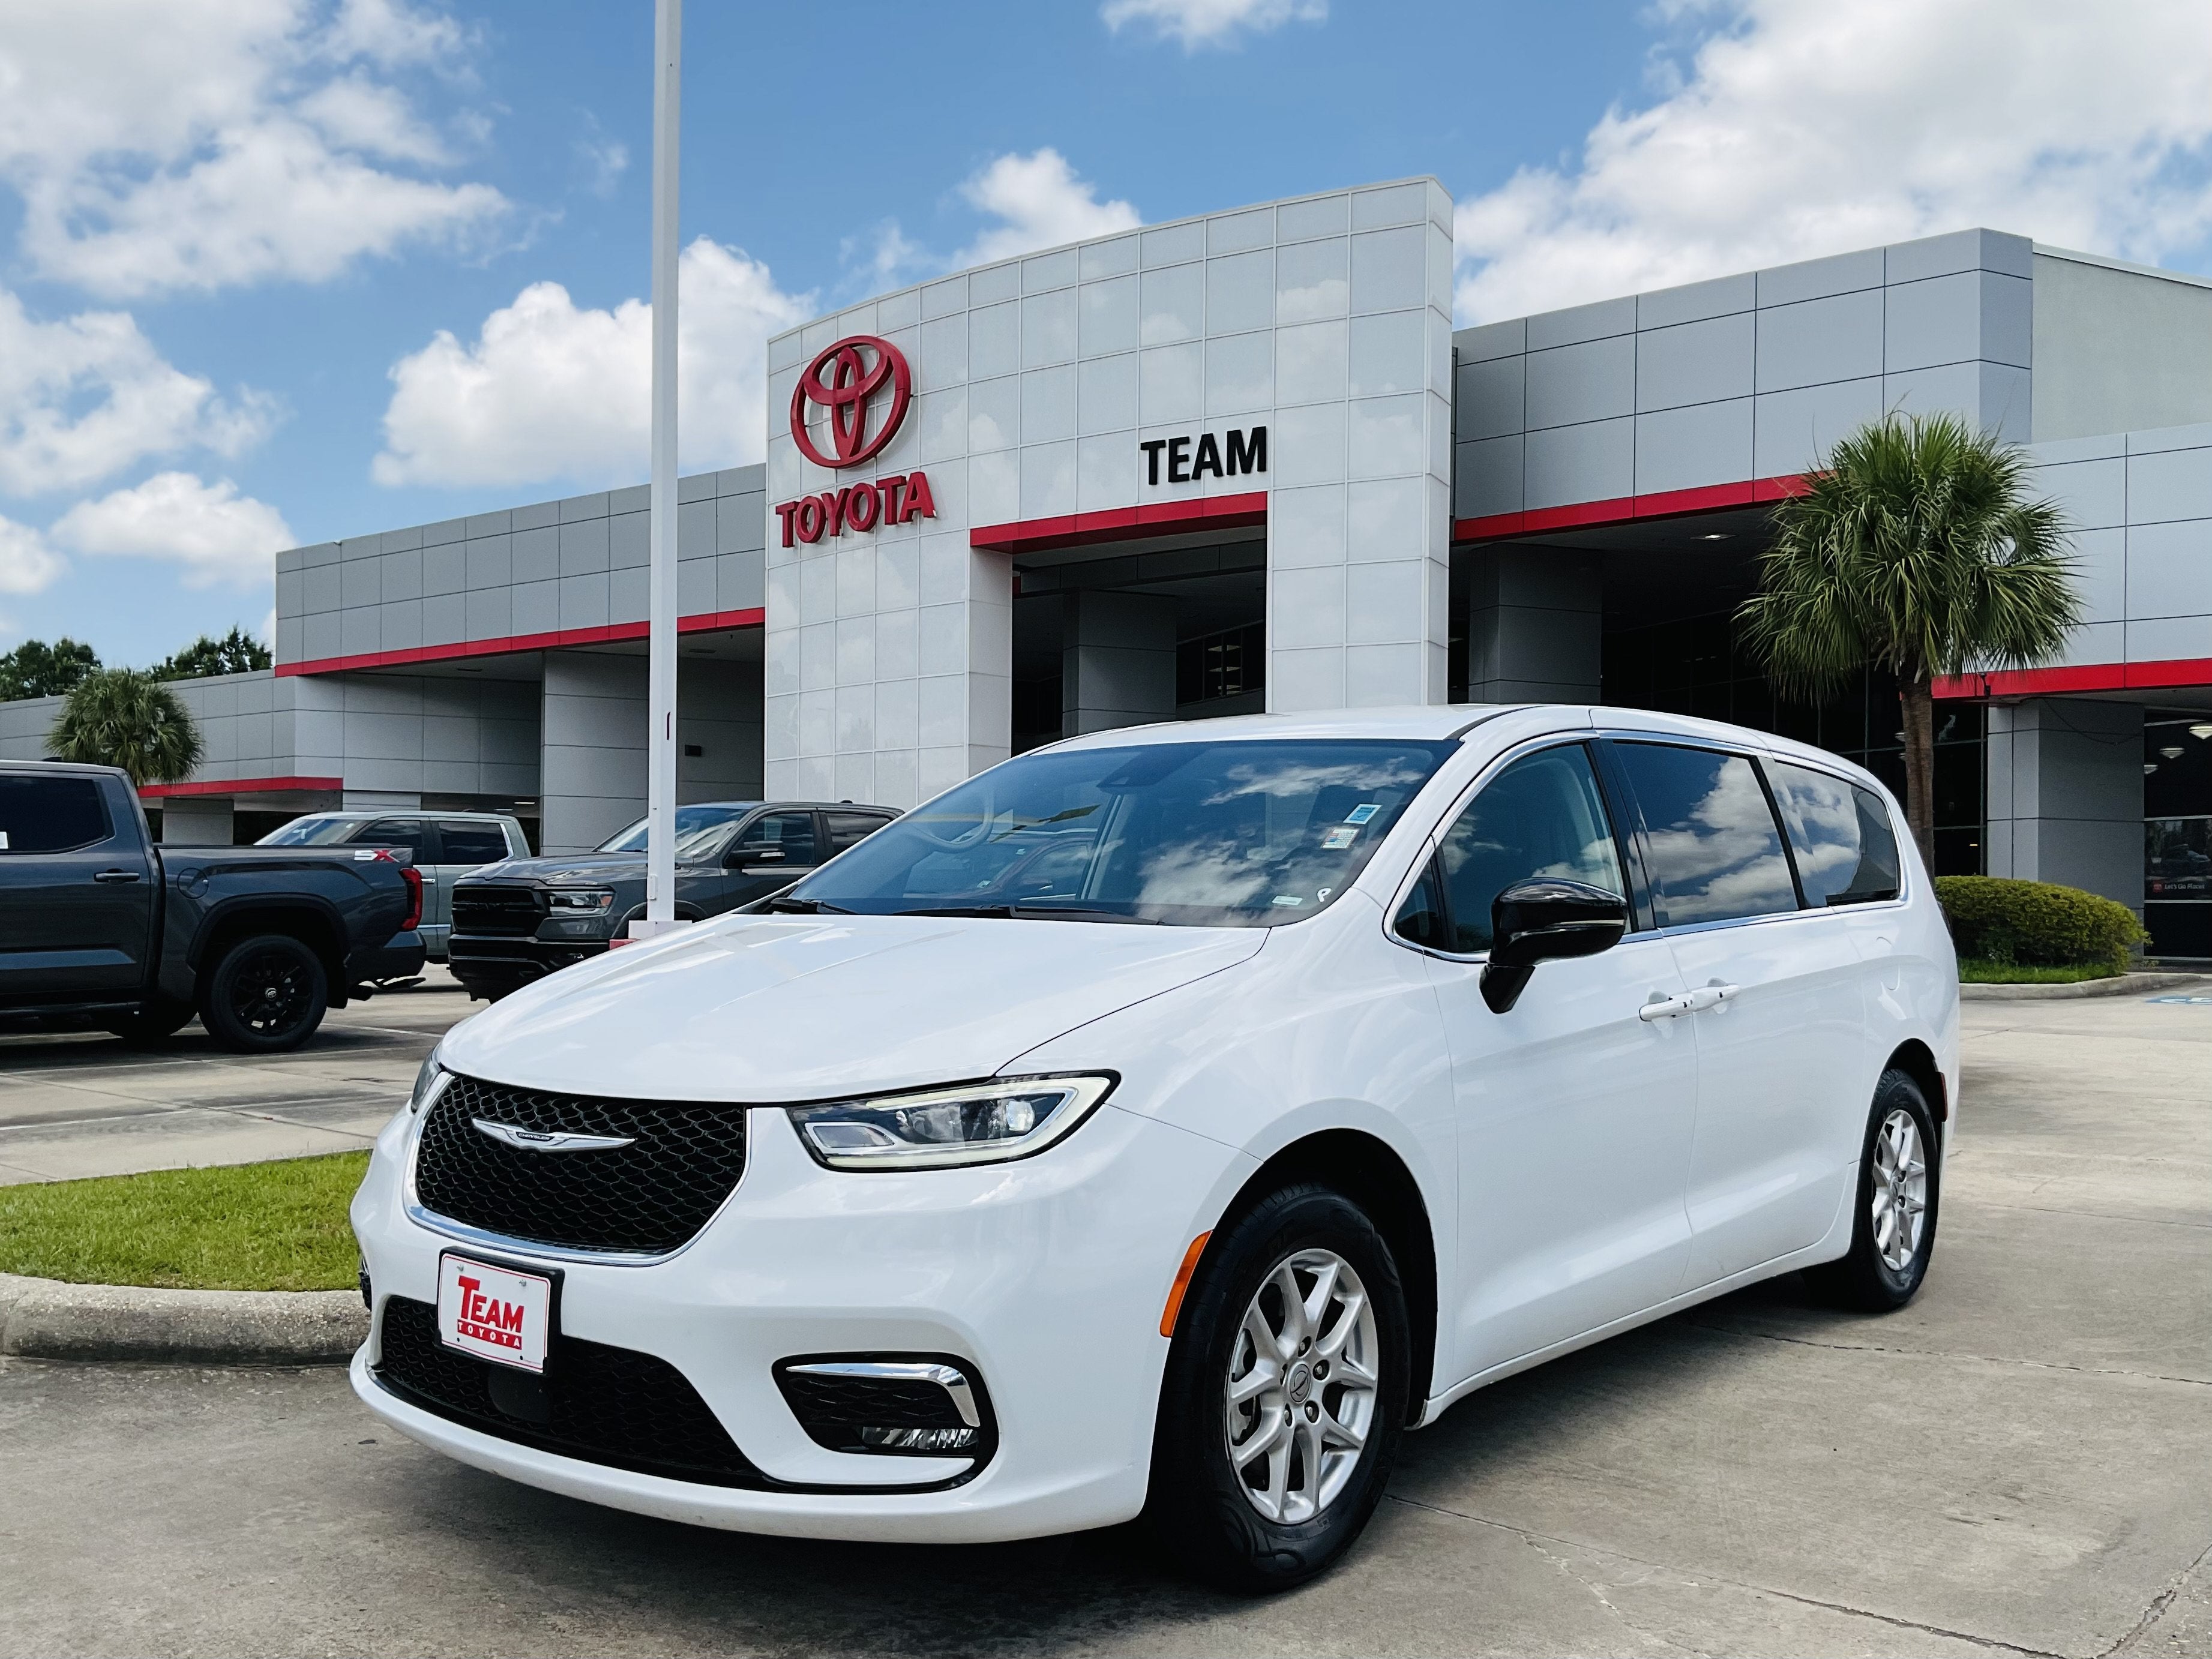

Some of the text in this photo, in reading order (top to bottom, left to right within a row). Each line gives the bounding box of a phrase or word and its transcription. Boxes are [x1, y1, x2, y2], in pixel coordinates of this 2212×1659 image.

[1140, 426, 1267, 485] TEAM
[775, 472, 937, 548] TOYOTA
[457, 1321, 521, 1348] TOYOTA
